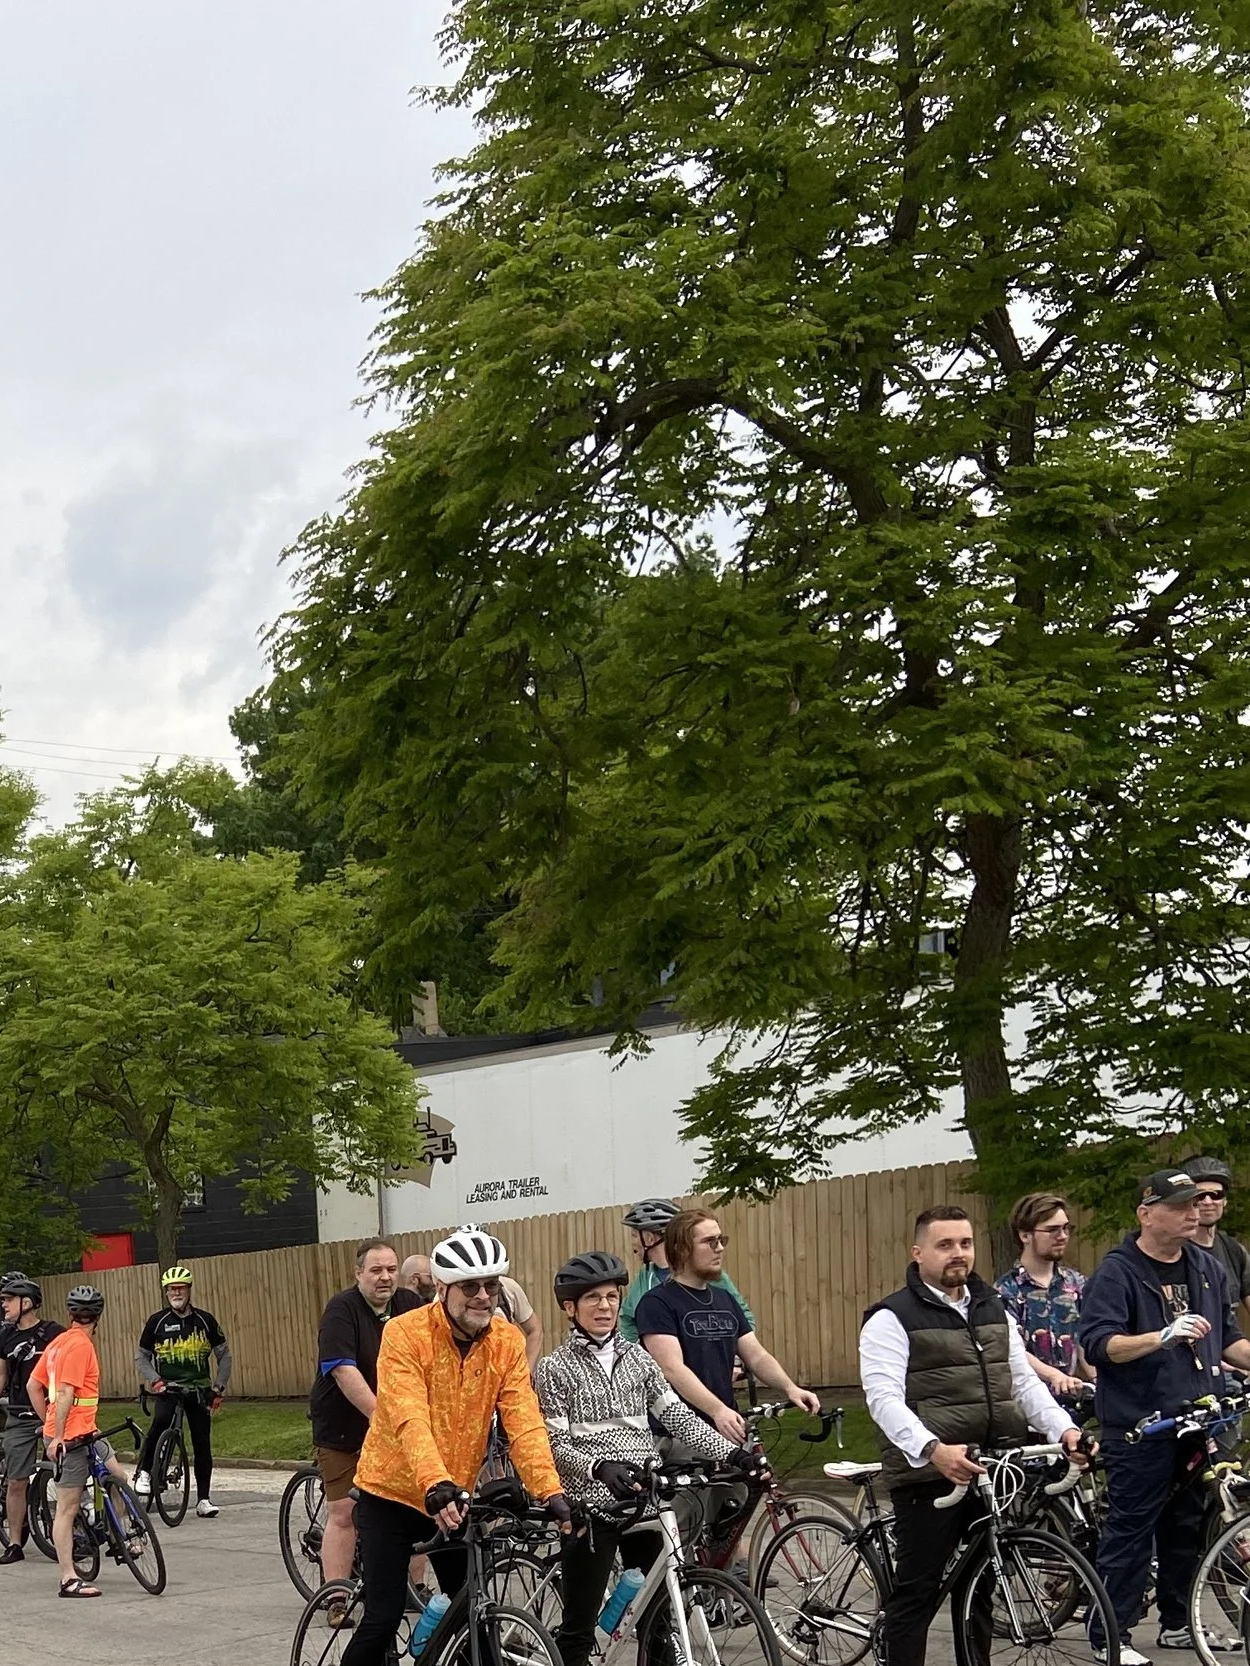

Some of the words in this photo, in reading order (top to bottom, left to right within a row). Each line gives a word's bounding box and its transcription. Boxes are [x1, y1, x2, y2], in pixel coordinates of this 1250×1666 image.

[474, 1181, 505, 1193] AURORA
[508, 1176, 540, 1189] TRAILER
[466, 1192, 498, 1204] LEASING
[500, 1190, 517, 1200] AND
[519, 1186, 549, 1198] RENTAL
